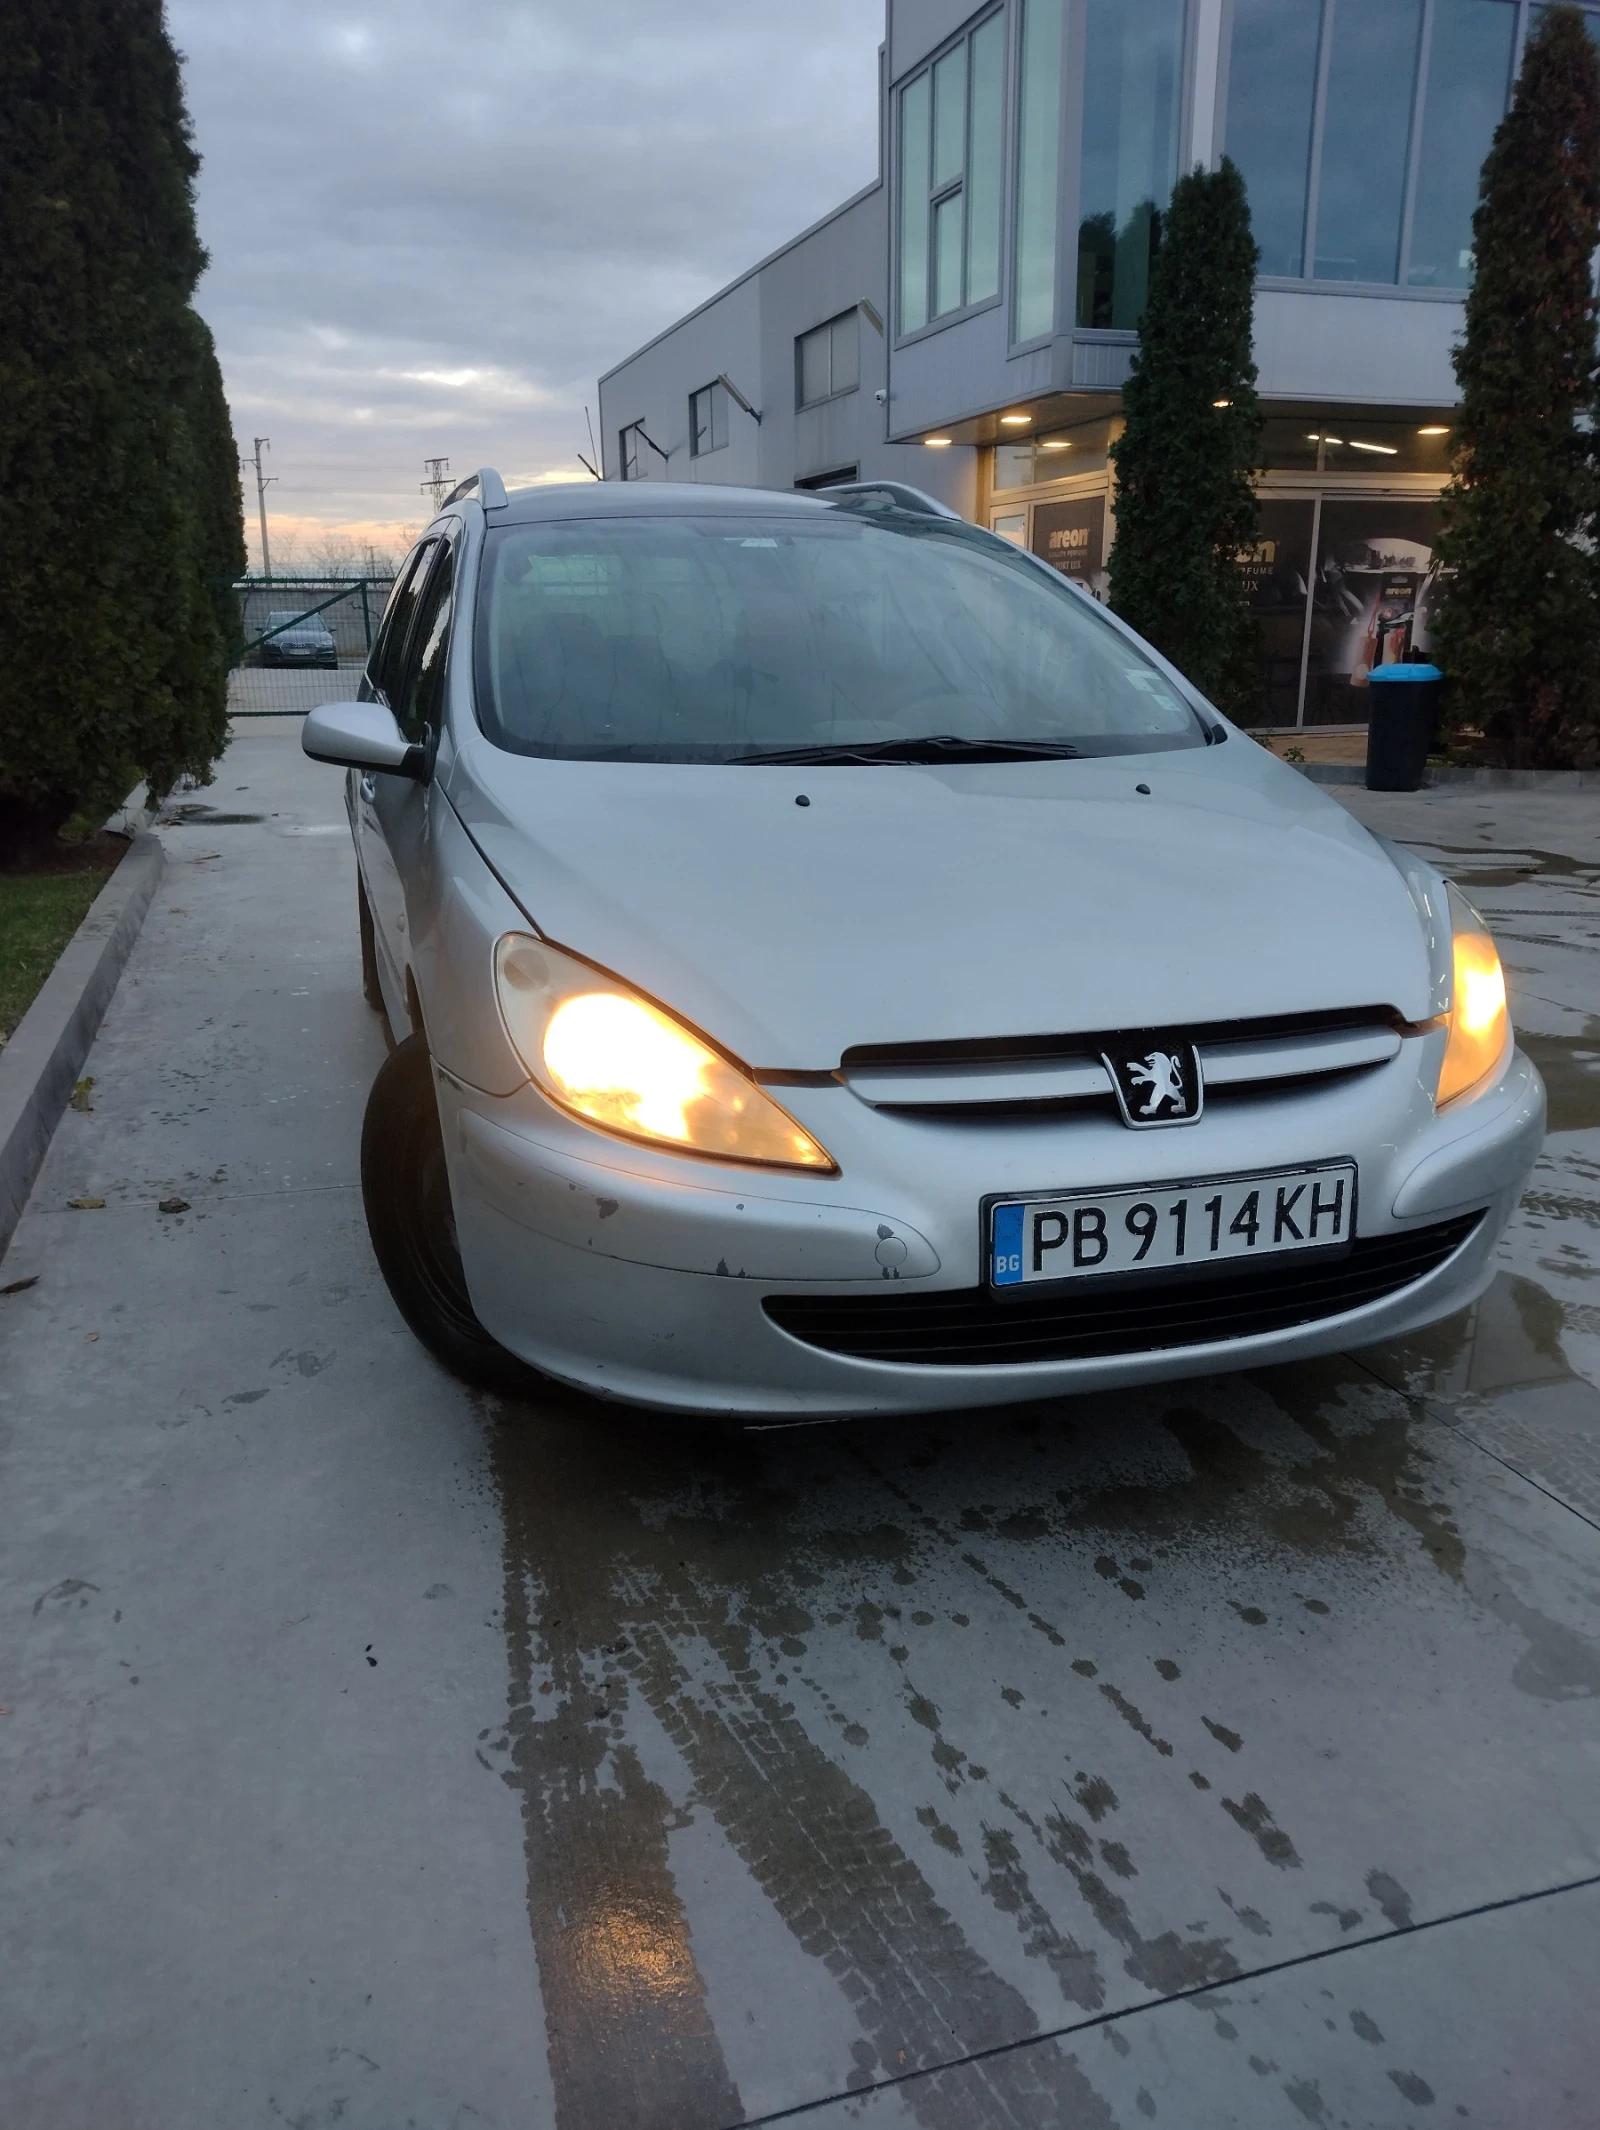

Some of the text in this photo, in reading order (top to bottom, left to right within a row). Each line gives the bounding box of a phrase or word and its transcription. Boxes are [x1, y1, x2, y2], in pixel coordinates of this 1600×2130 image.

[1049, 529, 1089, 549] areon
[1033, 1207, 1109, 1272] PB
[1125, 1190, 1261, 1261] 9114
[996, 1254, 1020, 1274] BG
